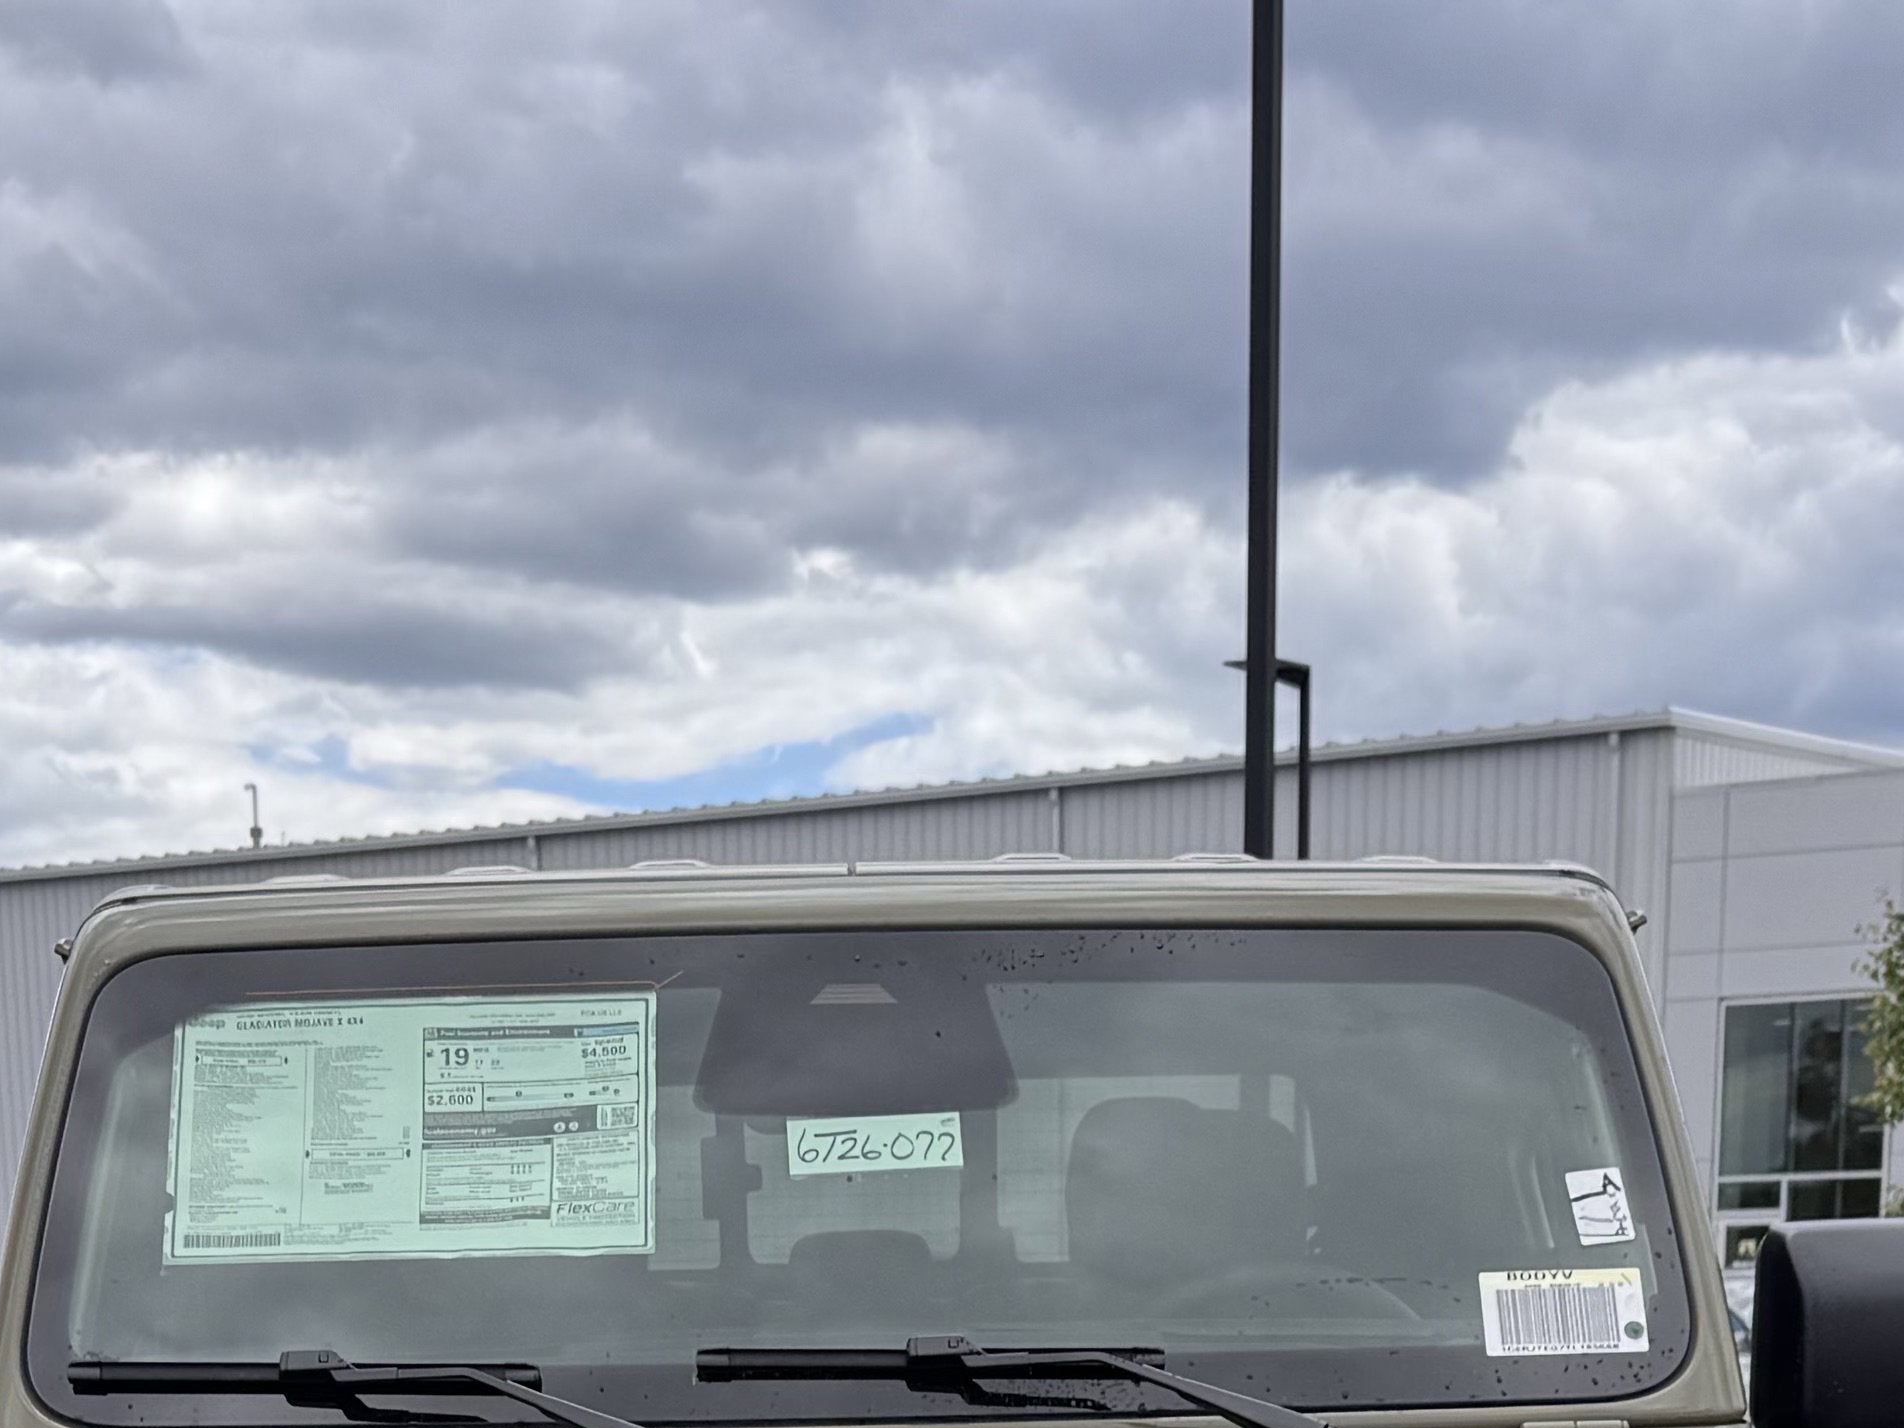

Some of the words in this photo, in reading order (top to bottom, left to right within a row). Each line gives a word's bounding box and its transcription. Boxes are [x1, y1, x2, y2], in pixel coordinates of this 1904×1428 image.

[236, 1019, 291, 1031] GLADIATOR
[294, 1018, 333, 1028] MOJAVE
[440, 1047, 469, 1066] 19
[557, 1201, 635, 1214] FlexCare
